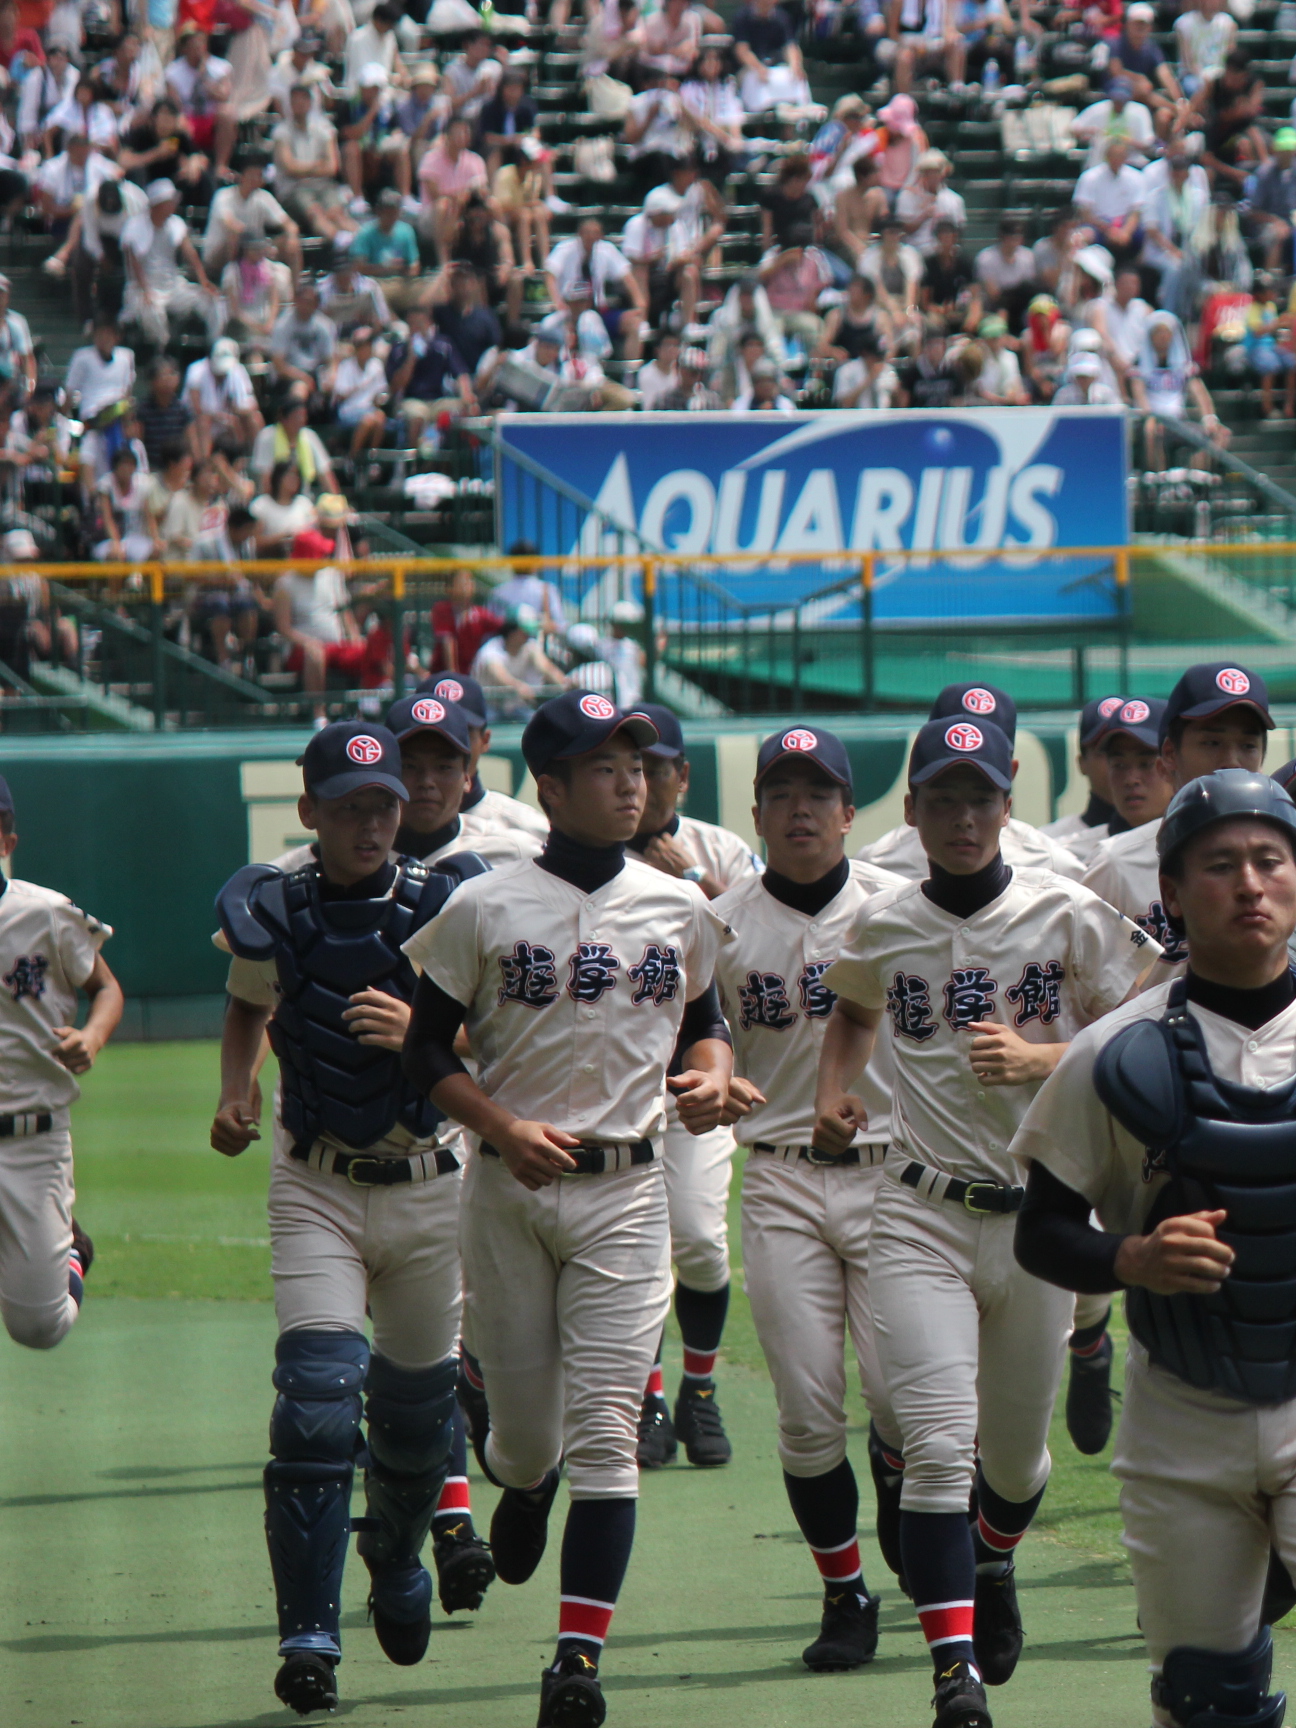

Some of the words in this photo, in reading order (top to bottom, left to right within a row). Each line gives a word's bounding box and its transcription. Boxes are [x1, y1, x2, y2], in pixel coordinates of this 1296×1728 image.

[563, 451, 1064, 575] AQUARIUS
[498, 940, 687, 1010] 遊学館
[737, 960, 840, 1032] 遊学
[886, 960, 1065, 1042] 遊学館
